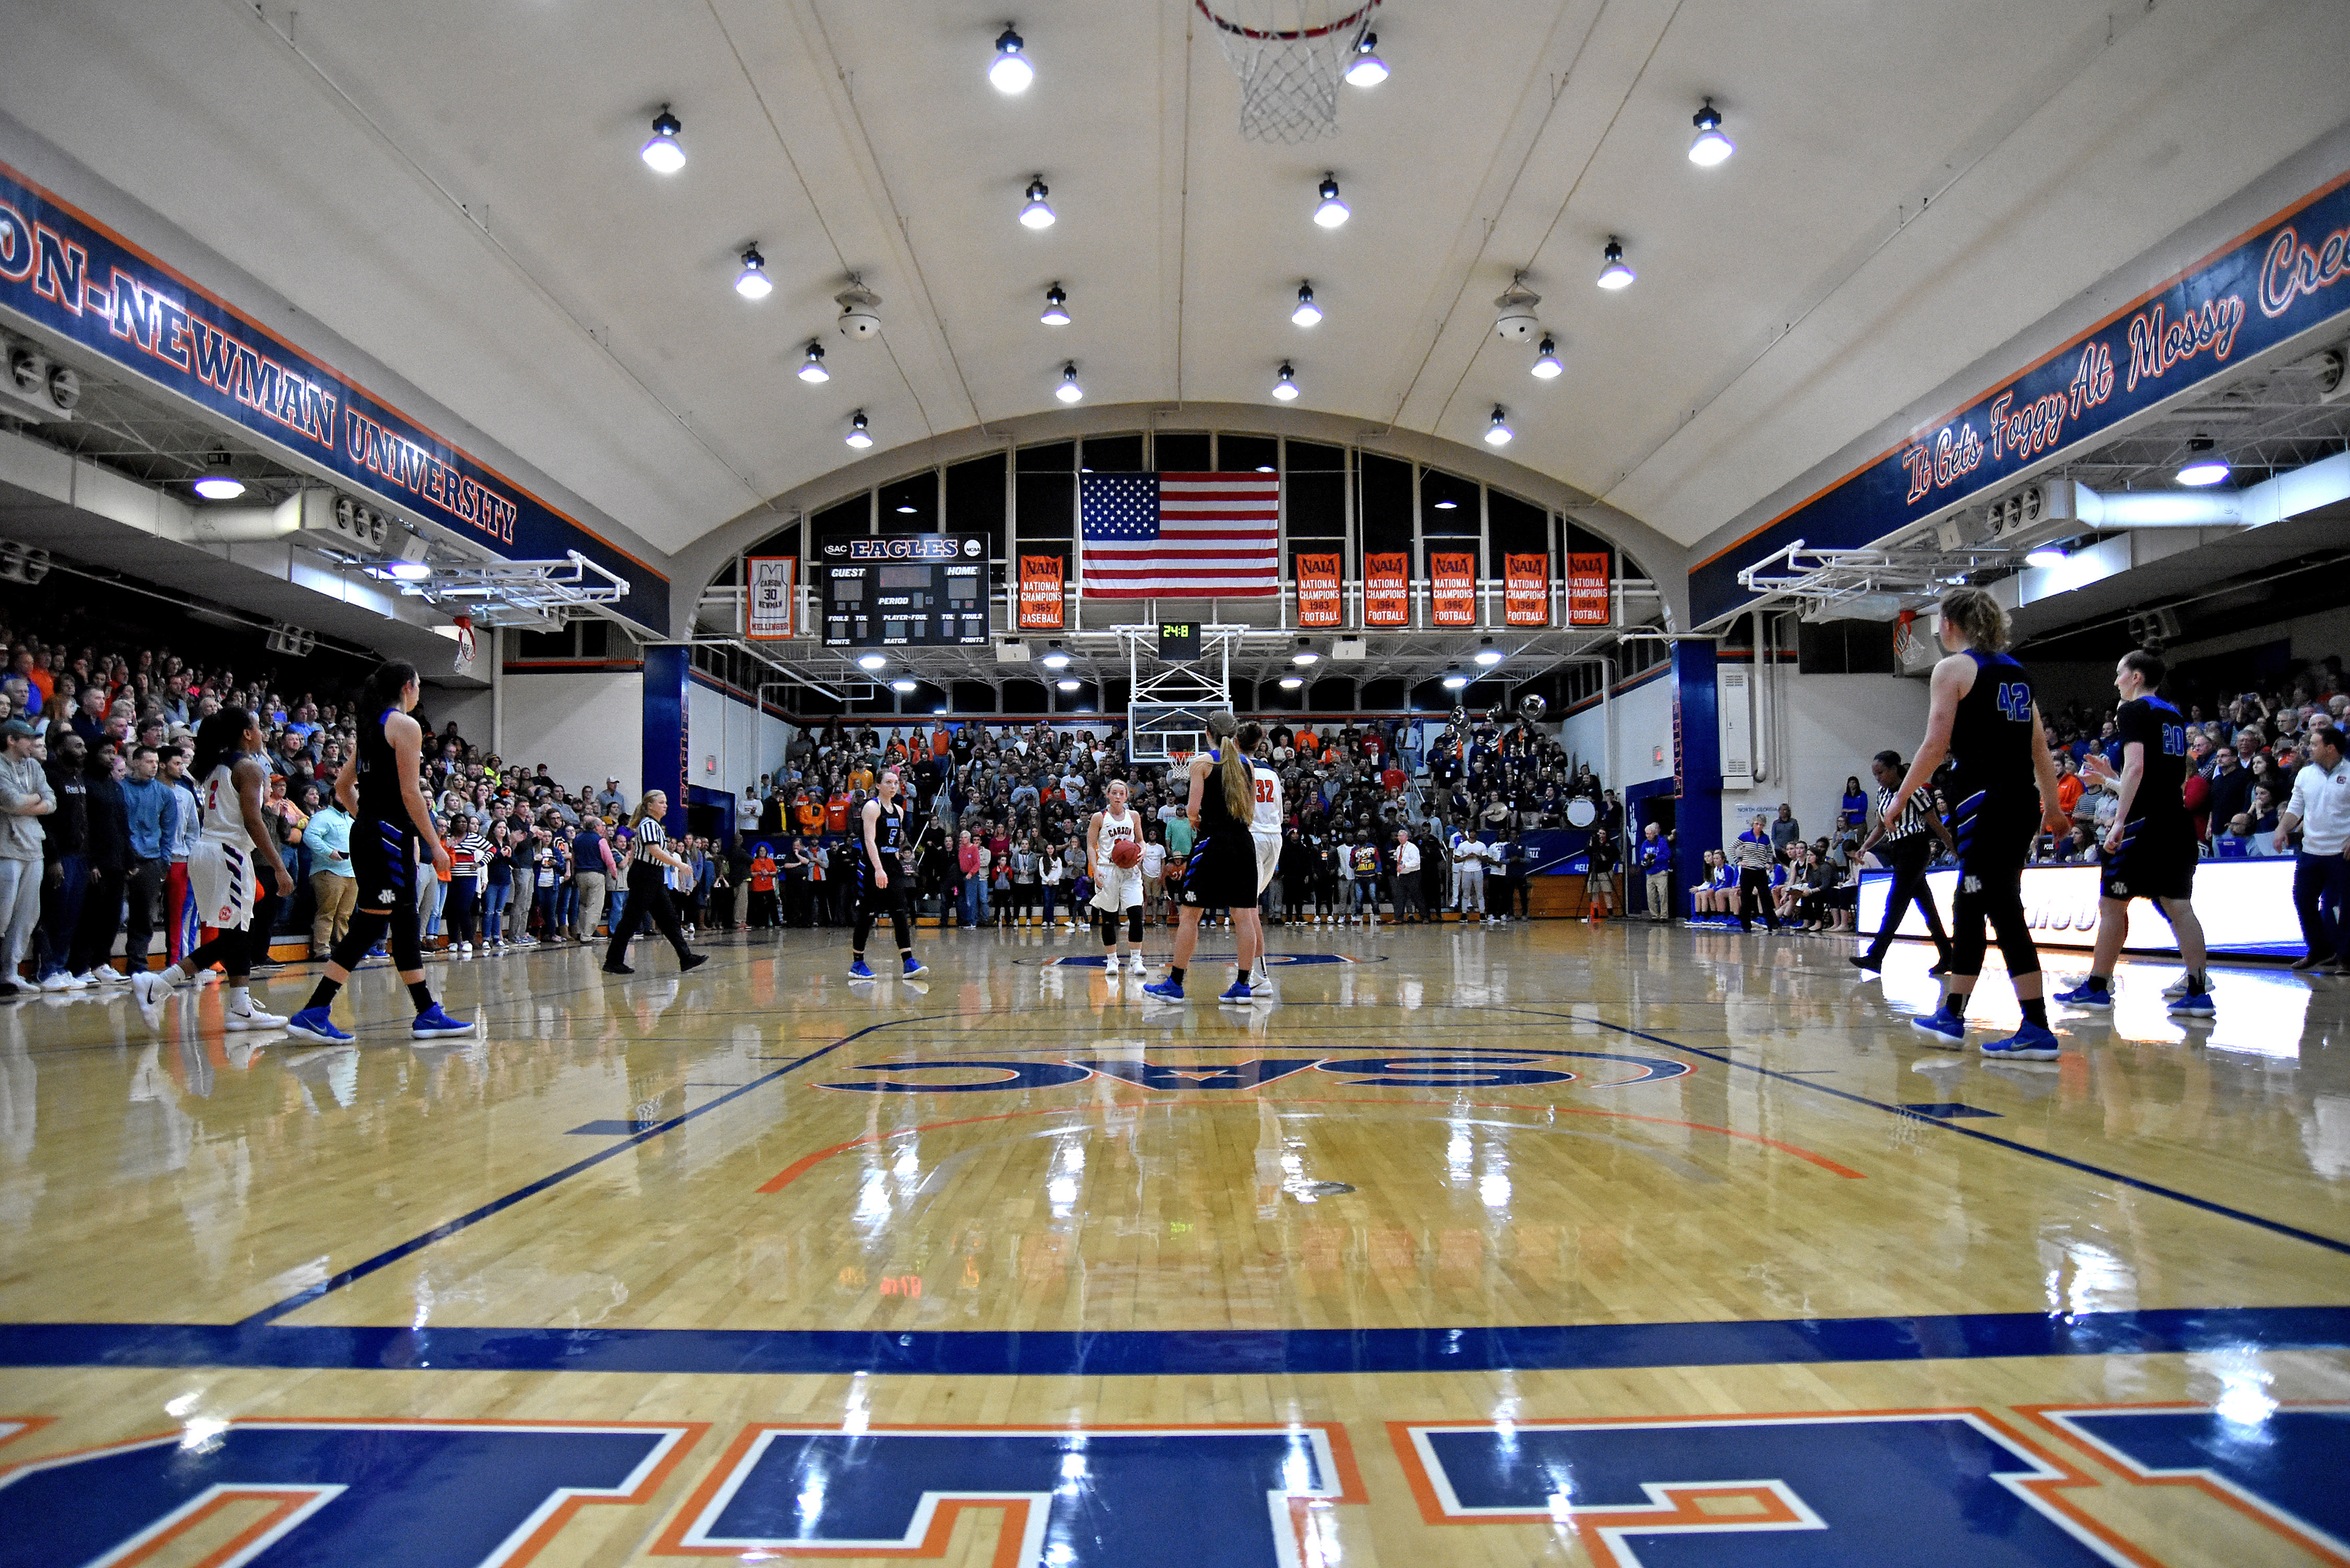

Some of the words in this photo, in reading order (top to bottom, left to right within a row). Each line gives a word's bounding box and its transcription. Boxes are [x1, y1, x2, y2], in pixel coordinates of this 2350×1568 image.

[1934, 423, 1984, 489] Gets
[1990, 390, 2068, 460] Foggy
[2069, 342, 2114, 419] At
[2127, 295, 2245, 392] Mossy
[345, 403, 517, 545] UNIVERSITY
[826, 545, 848, 554] SAC
[851, 540, 959, 559] EAGLES
[947, 566, 978, 576] HOME
[1025, 560, 1060, 578] NAIA
[1302, 558, 1335, 575] NAIA
[1370, 557, 1402, 575] NAIA
[1436, 558, 1469, 575] NAIA
[1510, 557, 1542, 575] NAIA
[1569, 557, 1603, 575] NAIA
[831, 568, 866, 578] GUEST
[760, 580, 782, 588] CARSON
[1023, 581, 1060, 591] NATIONAL
[1301, 579, 1338, 589] NATIONAL
[1368, 579, 1404, 588] NATIONAL
[1434, 578, 1471, 588] NATIONAL
[1508, 579, 1543, 589] NATIONAL
[1568, 578, 1605, 588] NATIONAL
[764, 589, 777, 600] 30
[1020, 592, 1062, 602] CHAMPIONS
[1300, 590, 1340, 600] CHAMPIONS
[1366, 589, 1406, 599] CHAMPIONS
[1433, 589, 1474, 599] CHAMPIONS
[1506, 590, 1546, 599] CHAMPIONS
[1567, 588, 1608, 598] CHAMPIONS
[758, 600, 782, 609] NEWMAN
[878, 597, 909, 606] PERIOD
[1310, 601, 1329, 610] 1983
[1377, 601, 1396, 610] 1984
[1517, 601, 1536, 610] 1988
[1021, 613, 1060, 624] BASEBALL
[1301, 611, 1339, 622] FOOTBALL
[1368, 610, 1405, 621] FOOTBALL
[1435, 611, 1472, 621] FOOTBALL
[1507, 611, 1544, 621] FOOTBALL
[1569, 610, 1605, 620] FOOTBALL
[1163, 625, 1189, 638] 24:8
[1996, 682, 2031, 722] 42
[2162, 723, 2186, 756] 20
[1256, 780, 1274, 802] 32
[1108, 826, 1132, 838] CARSON
